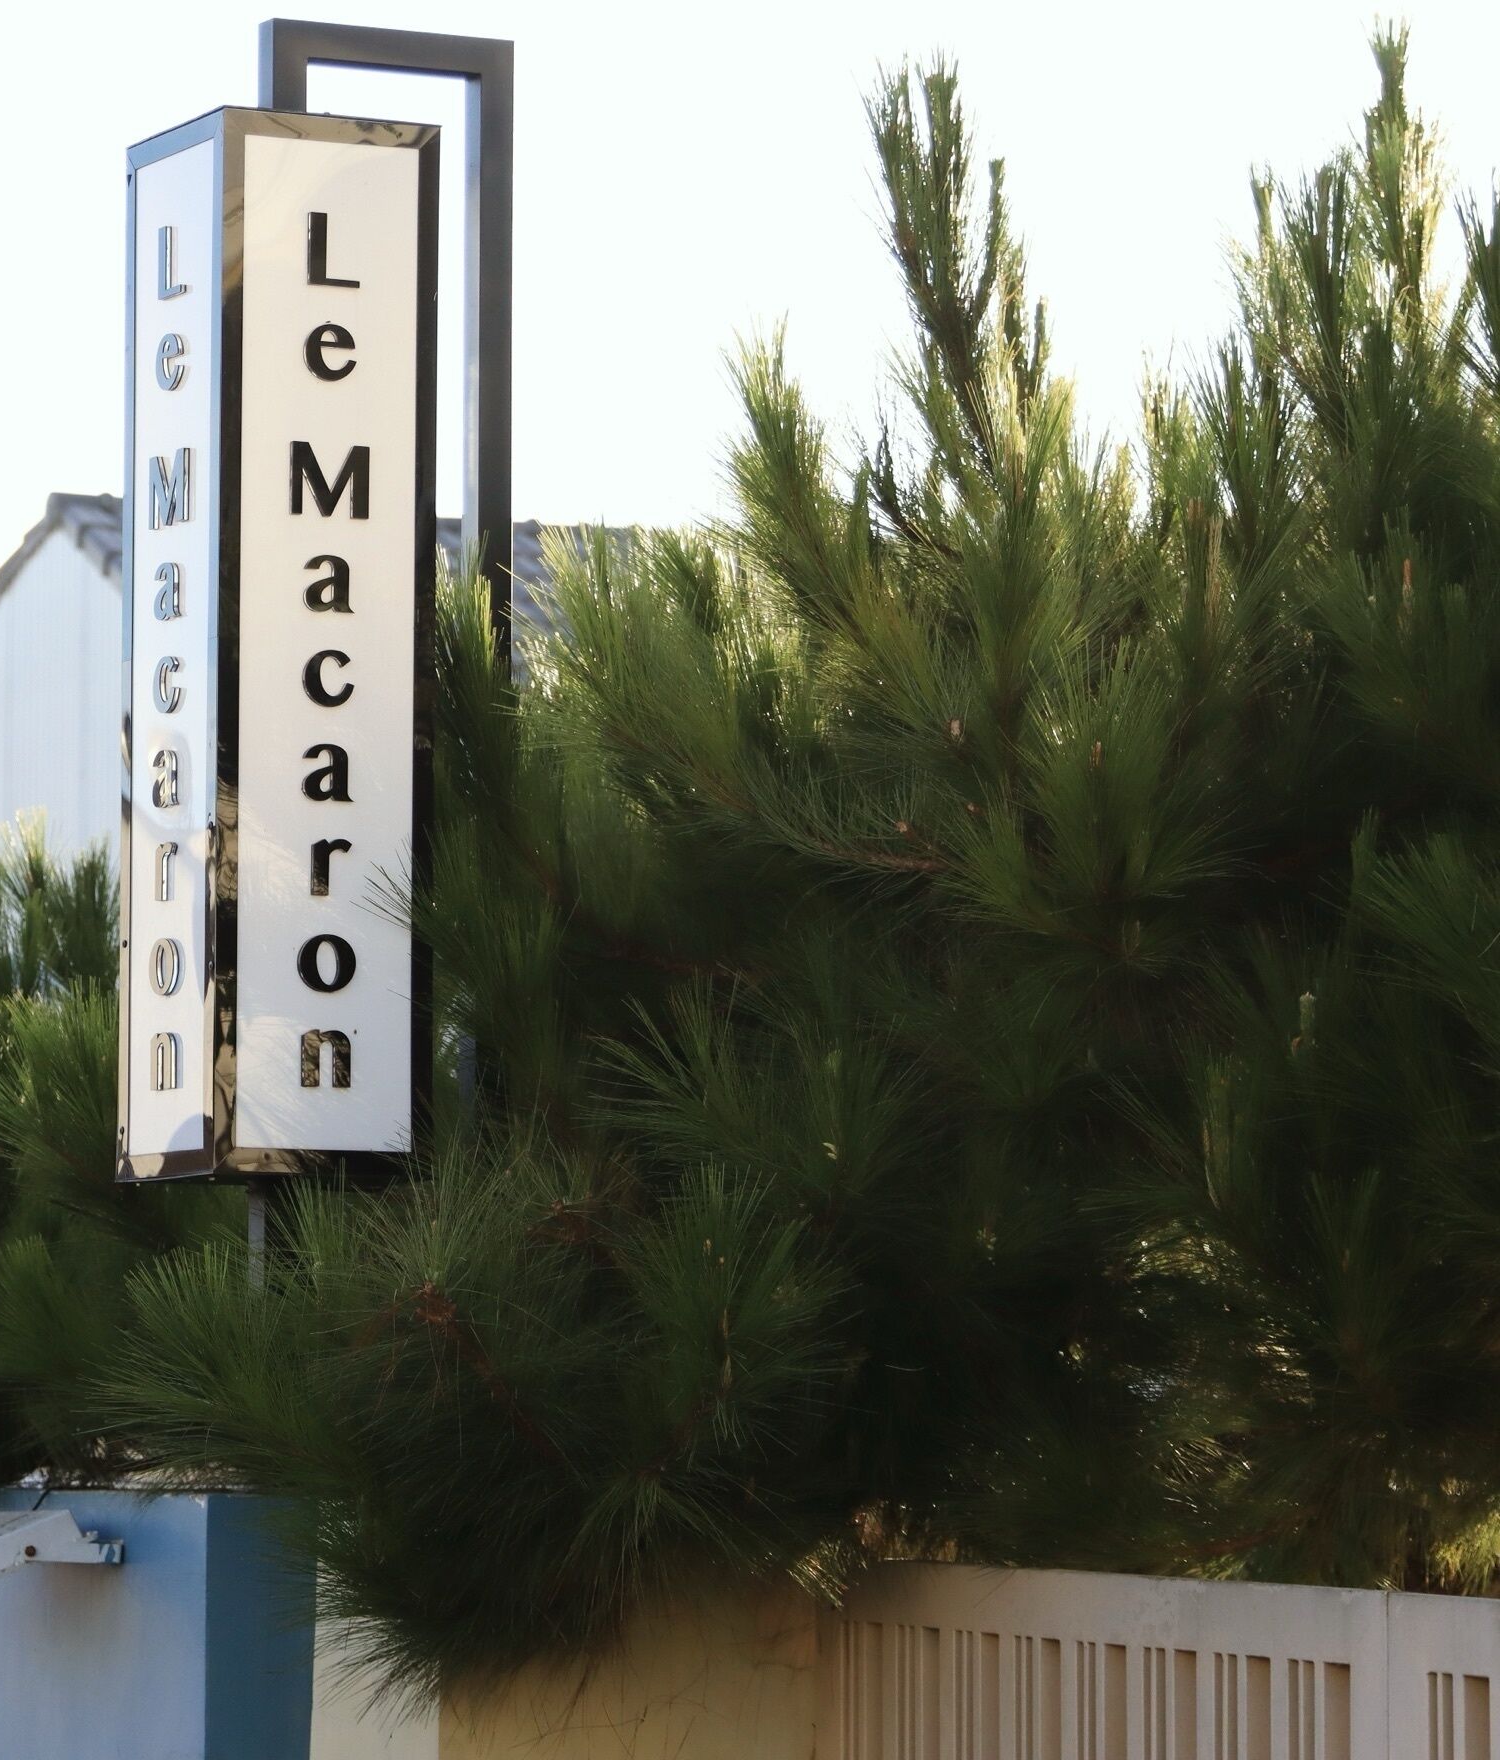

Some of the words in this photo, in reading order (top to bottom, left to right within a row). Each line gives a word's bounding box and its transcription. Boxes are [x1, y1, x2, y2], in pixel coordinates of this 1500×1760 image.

[155, 225, 188, 392] Le
[303, 211, 360, 382] Le
[148, 447, 191, 1091] Macaron
[290, 440, 370, 1088] Macaron
